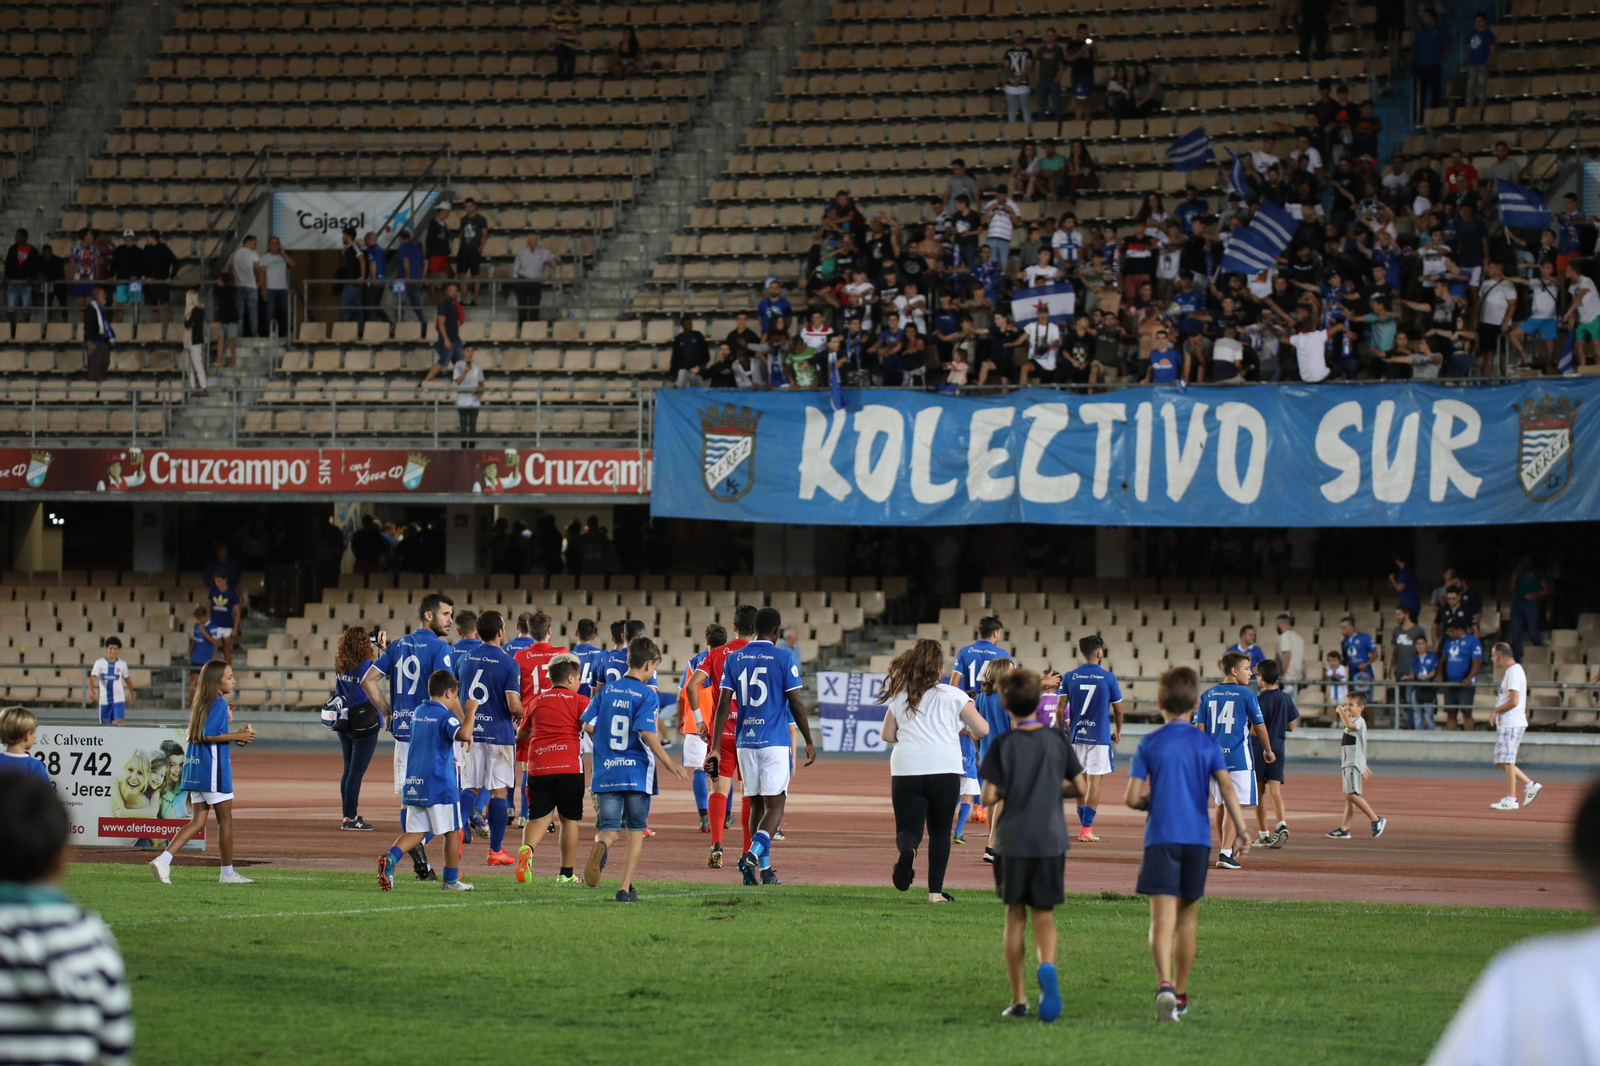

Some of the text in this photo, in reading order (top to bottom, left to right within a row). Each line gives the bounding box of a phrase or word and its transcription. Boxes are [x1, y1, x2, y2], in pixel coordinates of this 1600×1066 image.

[297, 210, 365, 233] Cajasol
[708, 441, 749, 481] XEREZ
[798, 399, 1483, 504] KOLECTIVO SUR
[1525, 432, 1567, 483] XEREZ
[12, 463, 27, 477] CD
[150, 451, 308, 489] Cruzcampo
[318, 458, 331, 485] SIN
[388, 465, 404, 479] CD
[395, 654, 420, 695] 19
[468, 669, 489, 705] 6
[738, 667, 768, 707] 15
[822, 676, 839, 696] X
[612, 699, 630, 709] JAVI
[1079, 685, 1097, 715] 7
[1208, 700, 1235, 733] 14
[40, 733, 104, 746] & Calvente
[610, 714, 629, 750] 9
[863, 728, 880, 748] C
[25, 751, 112, 776] 38 742
[72, 782, 111, 796] Jerez
[102, 823, 182, 836] www.ofertaseguro
